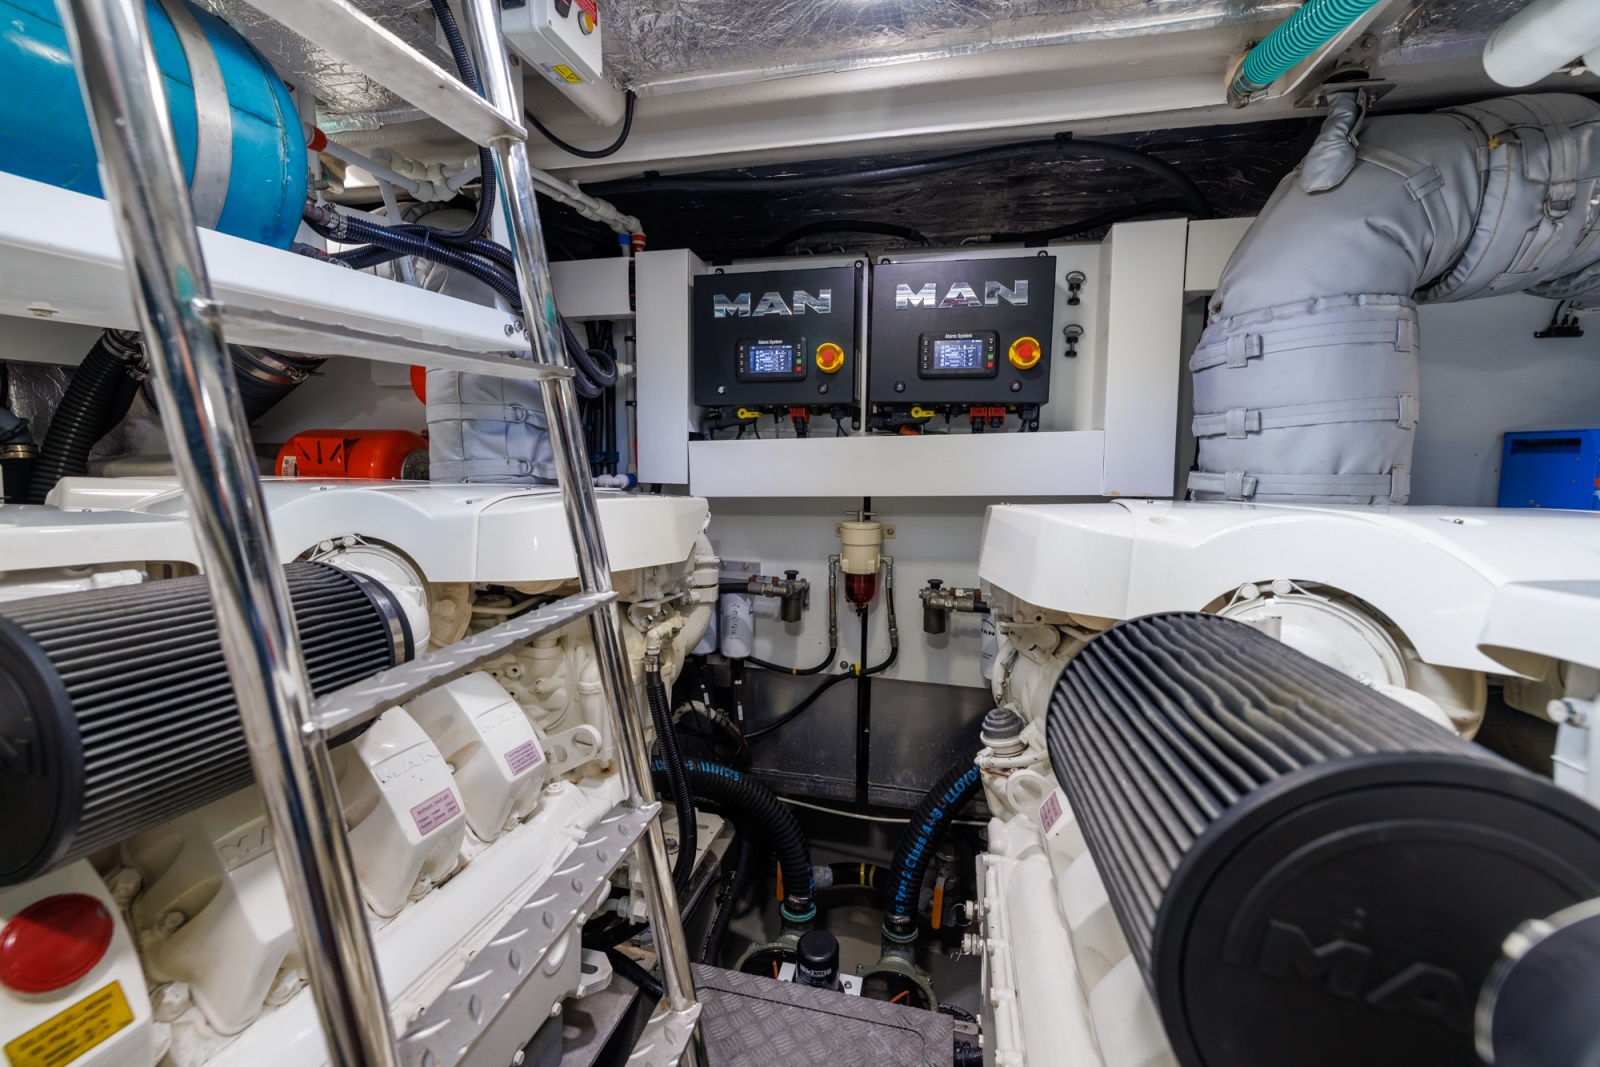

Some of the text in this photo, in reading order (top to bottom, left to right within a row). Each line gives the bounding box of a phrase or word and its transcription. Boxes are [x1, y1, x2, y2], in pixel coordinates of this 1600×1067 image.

[713, 289, 831, 318] MAN
[895, 280, 1028, 309] MAN
[701, 761, 741, 781] LLOYD'S
[921, 808, 943, 836] A+B
[904, 836, 927, 869] Class
[901, 871, 913, 880] 2
[895, 879, 908, 904] Type
[1257, 917, 1474, 1036] MA
